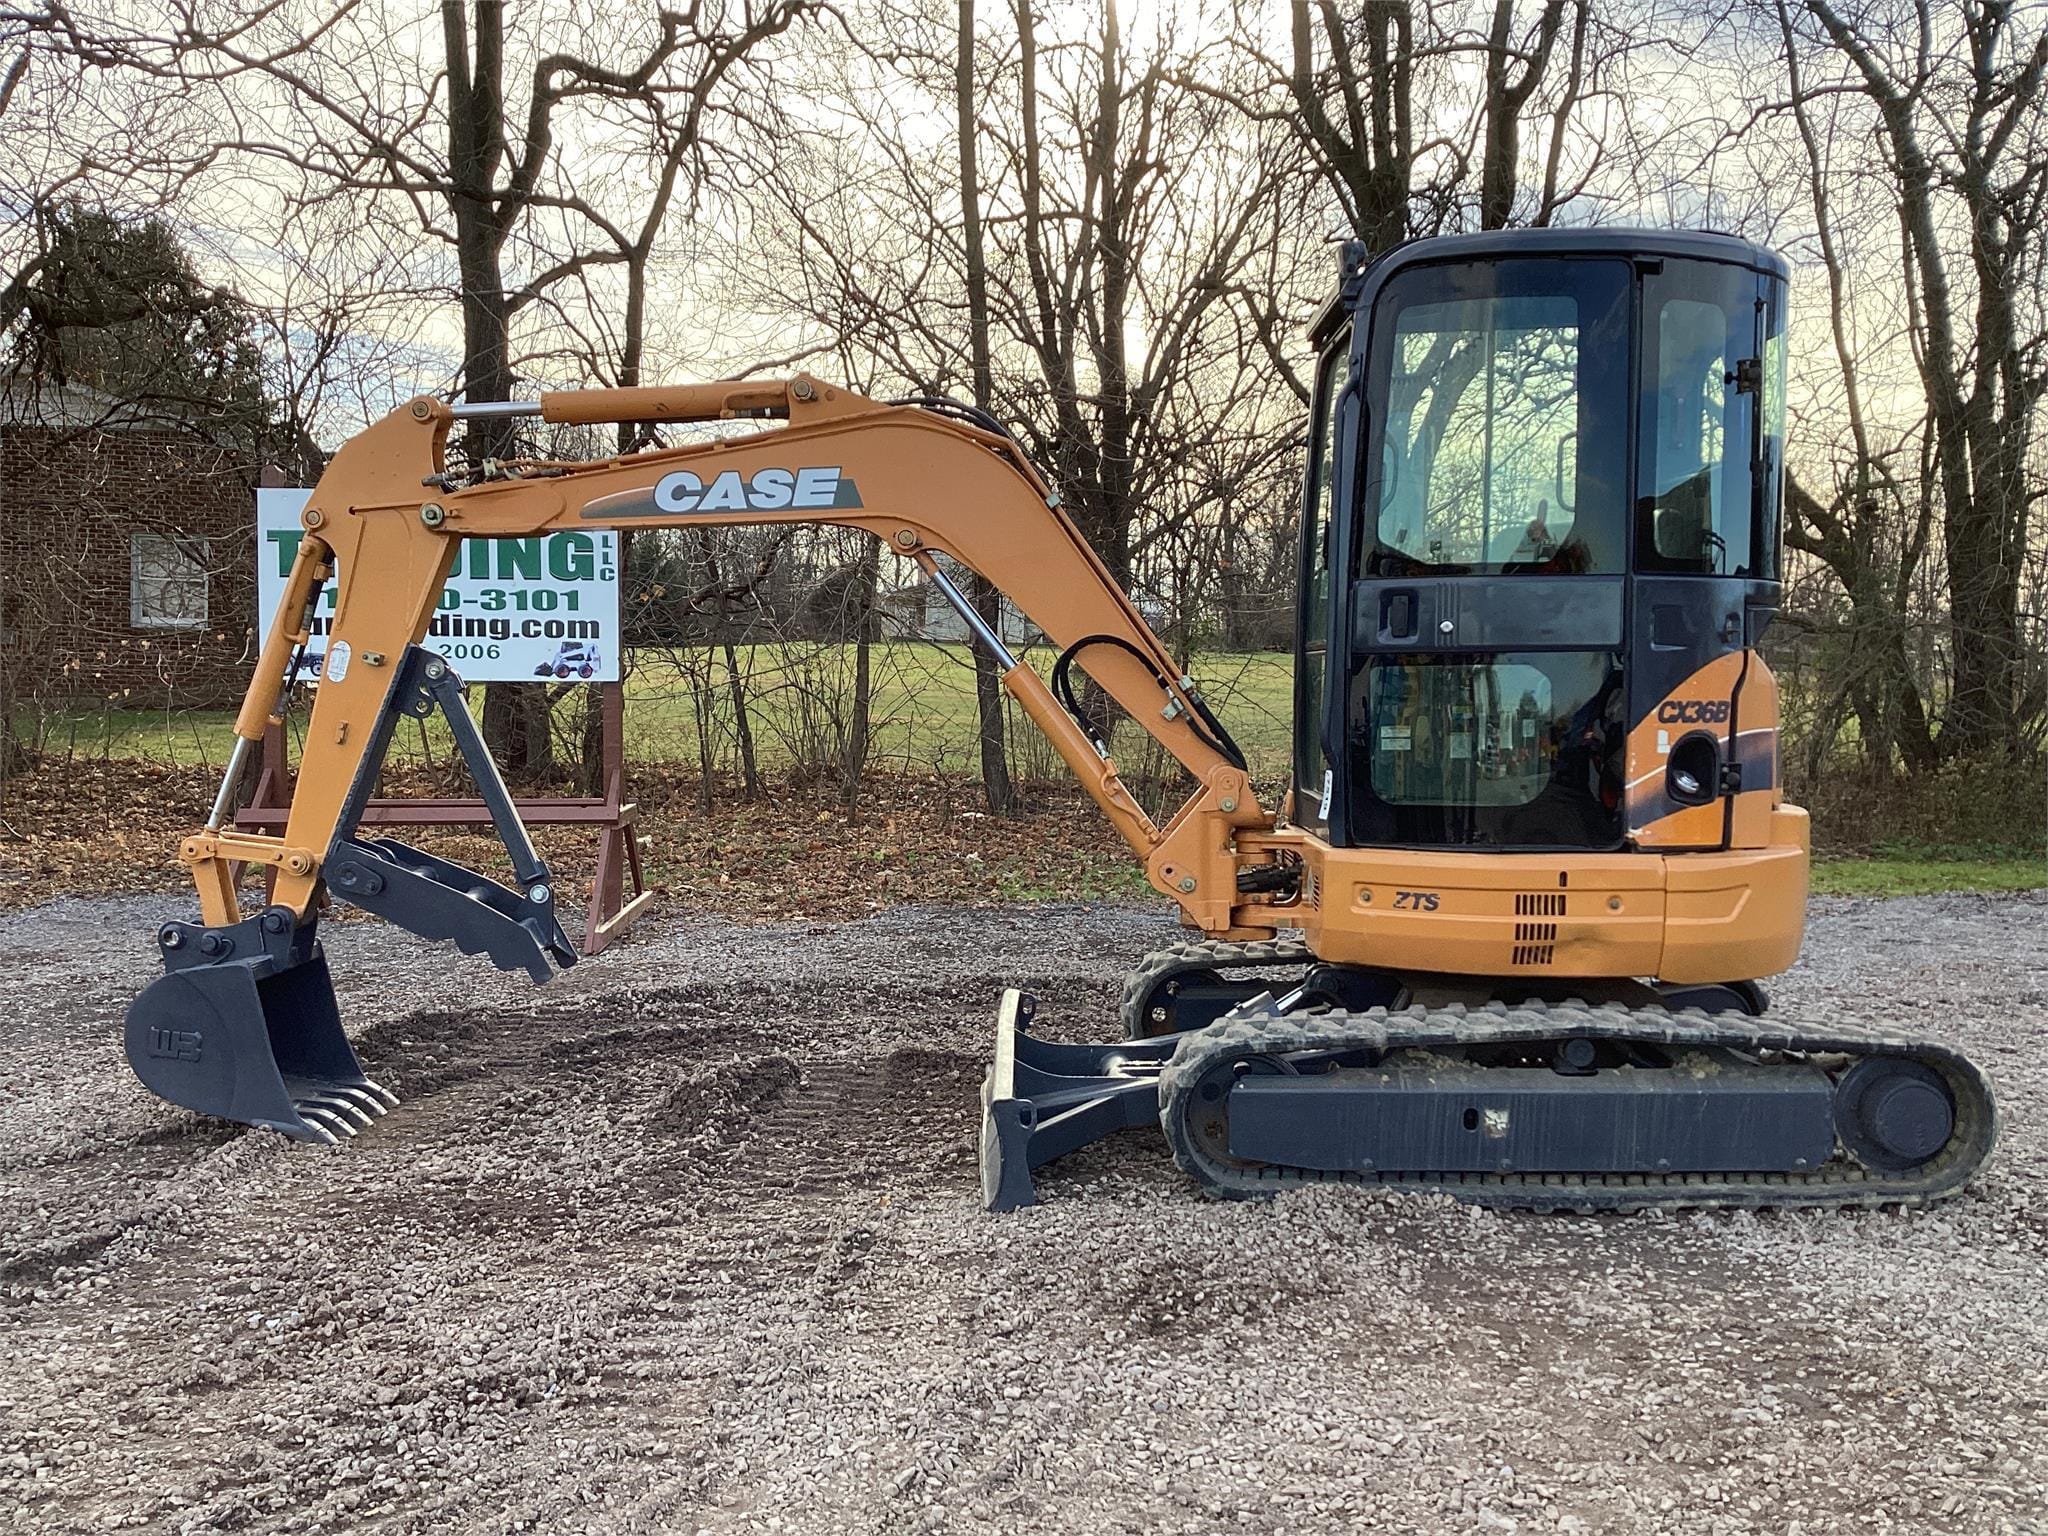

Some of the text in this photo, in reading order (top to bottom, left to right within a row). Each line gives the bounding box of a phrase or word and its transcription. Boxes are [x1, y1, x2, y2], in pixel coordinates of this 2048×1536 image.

[653, 467, 841, 513] CASE
[438, 643, 501, 660] 2006
[1658, 700, 1730, 724] CX36B
[1392, 891, 1441, 911] ZTS
